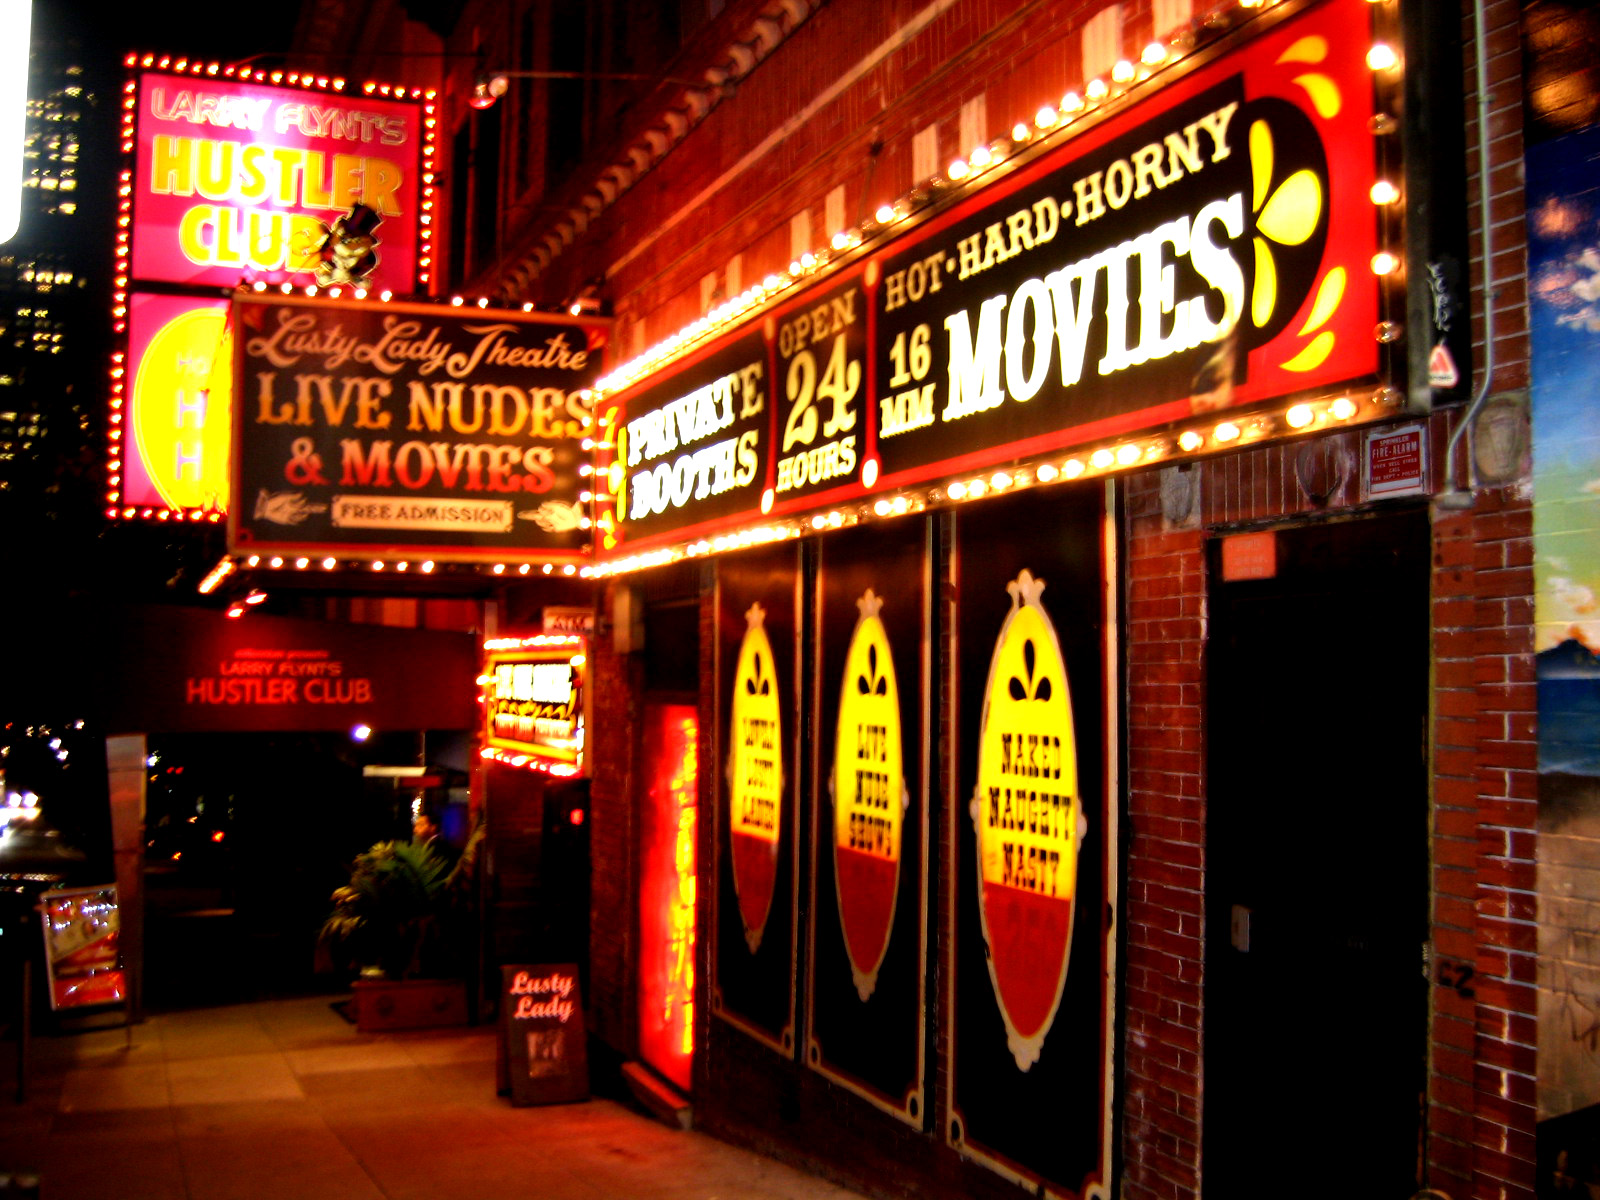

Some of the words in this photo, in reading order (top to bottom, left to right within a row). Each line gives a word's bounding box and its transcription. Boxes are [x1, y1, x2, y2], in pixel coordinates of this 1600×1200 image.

[151, 88, 272, 130] LARRY
[151, 135, 403, 216] HUSTLER
[884, 250, 946, 313] HOT
[956, 196, 1059, 280] HARD
[1073, 101, 1238, 227] HORNY
[179, 204, 327, 273] CLUB
[779, 289, 857, 358] OPEN
[942, 192, 1244, 422] MOVIES
[247, 308, 356, 369] Lusty
[354, 314, 450, 374] Lady
[447, 323, 587, 378] Theatre
[889, 324, 931, 389] 16
[256, 372, 392, 430] LIVE
[407, 381, 597, 440] NUDES
[627, 361, 764, 467] PRIVATE
[782, 332, 861, 452] 24
[879, 382, 936, 439] MM
[284, 437, 325, 487] &
[339, 440, 556, 494] MOVIES
[630, 430, 758, 520] BOOTHS
[776, 435, 856, 493] HOURS
[341, 503, 391, 519] FREE
[396, 505, 504, 523] ADMISSION
[186, 678, 298, 704] HUSTLER
[304, 678, 373, 704] CLUB
[220, 660, 274, 676] LARRY
[1002, 733, 1060, 779] NAKED
[989, 786, 1071, 840] NAUGHTY
[1003, 842, 1059, 897] NASTY
[510, 970, 574, 998] Lusty
[514, 995, 574, 1023] Lady
